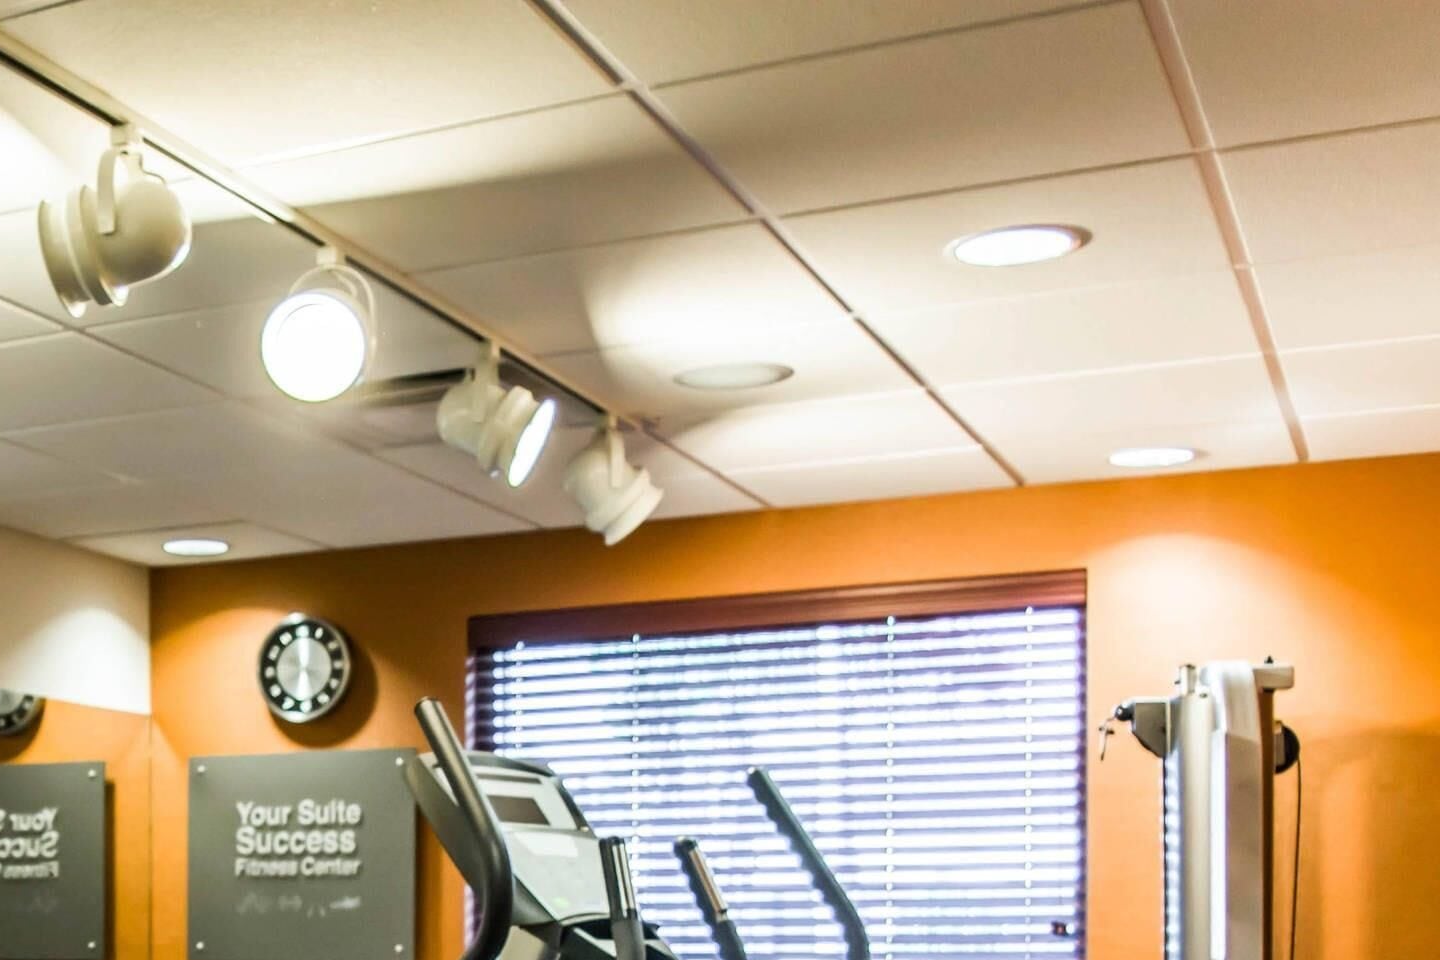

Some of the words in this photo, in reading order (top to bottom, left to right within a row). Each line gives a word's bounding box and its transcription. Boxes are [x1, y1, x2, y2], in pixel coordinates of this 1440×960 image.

[236, 801, 292, 826] Your
[297, 799, 362, 825] Suite
[235, 826, 357, 855] Success
[235, 857, 299, 877] Fitness
[300, 856, 362, 876] Center
